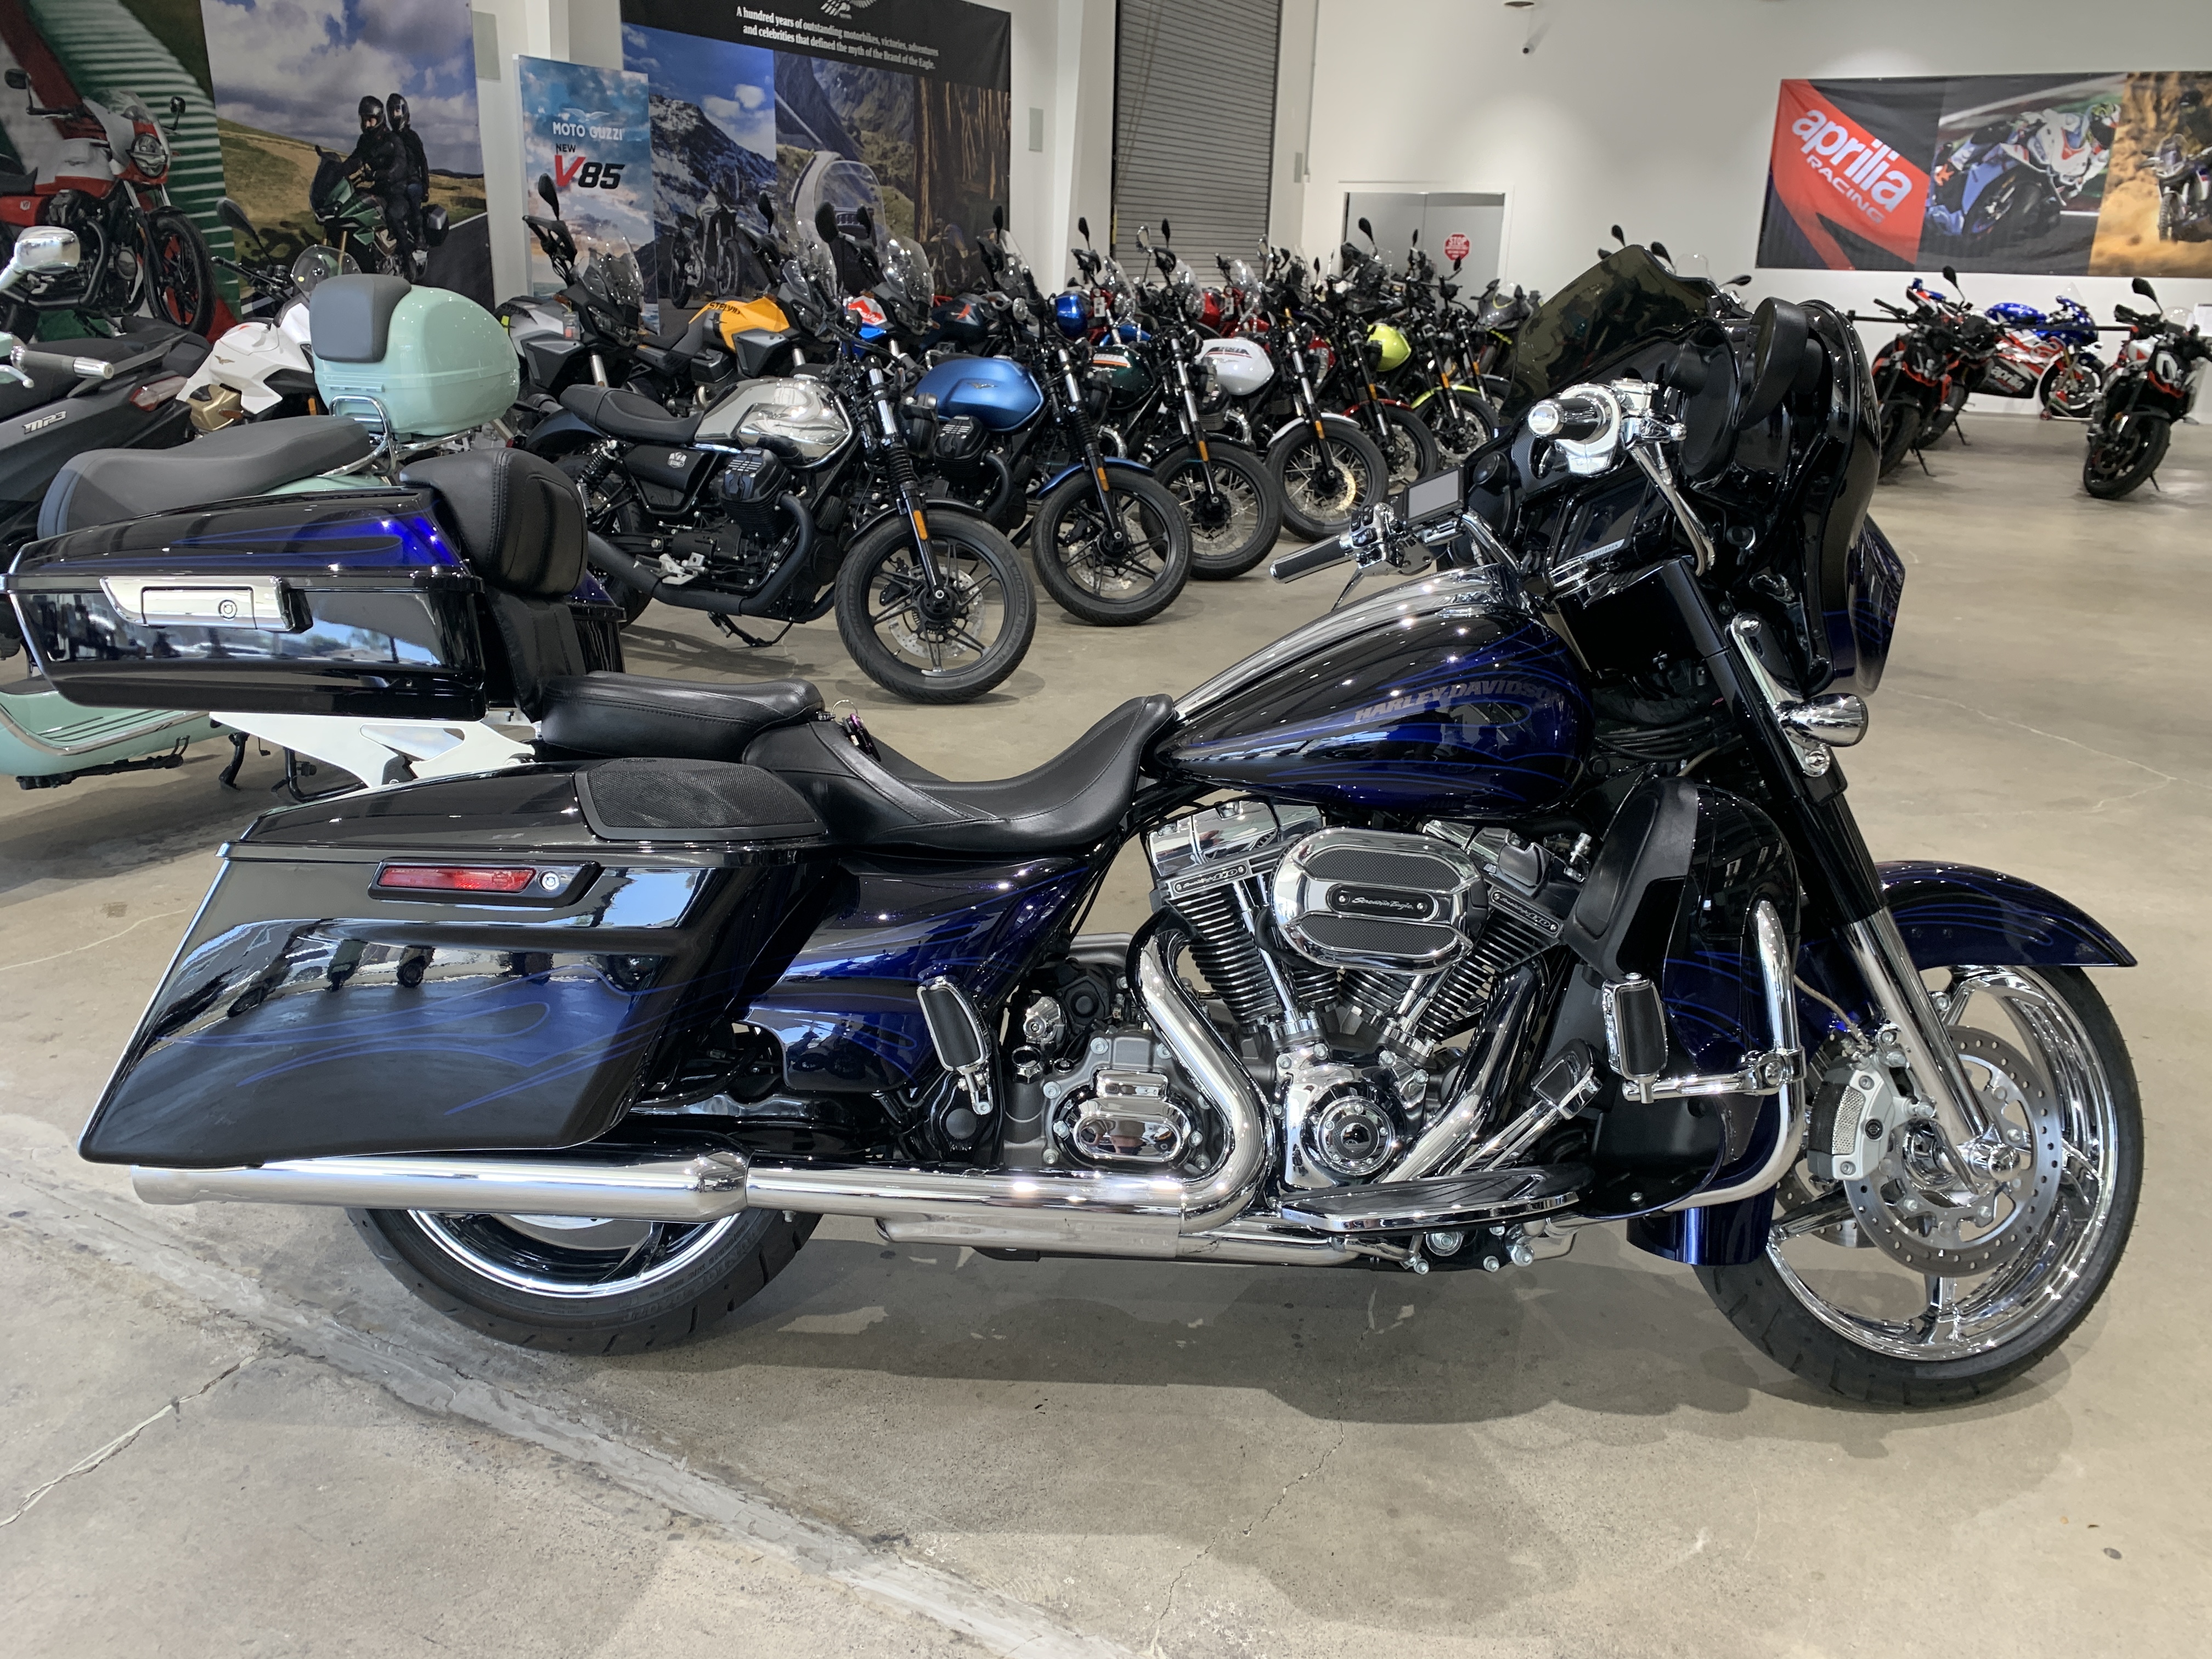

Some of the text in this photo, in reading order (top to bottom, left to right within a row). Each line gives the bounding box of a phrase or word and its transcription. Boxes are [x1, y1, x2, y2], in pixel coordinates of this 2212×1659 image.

[736, 5, 939, 57] A hundred years of outstanding motorbikes, victories, adventures
[743, 25, 936, 70] and celebrities that defined the myth of the Brand of the Eagle.
[552, 121, 624, 140] MOTO GUZZI
[556, 143, 576, 153] NEW
[1792, 110, 1912, 213] aprilia
[555, 155, 625, 189] V85
[1807, 154, 1886, 224] RACING
[1449, 236, 1466, 246] STOP
[1991, 365, 2025, 391] aprilia
[22, 410, 67, 435] MP3
